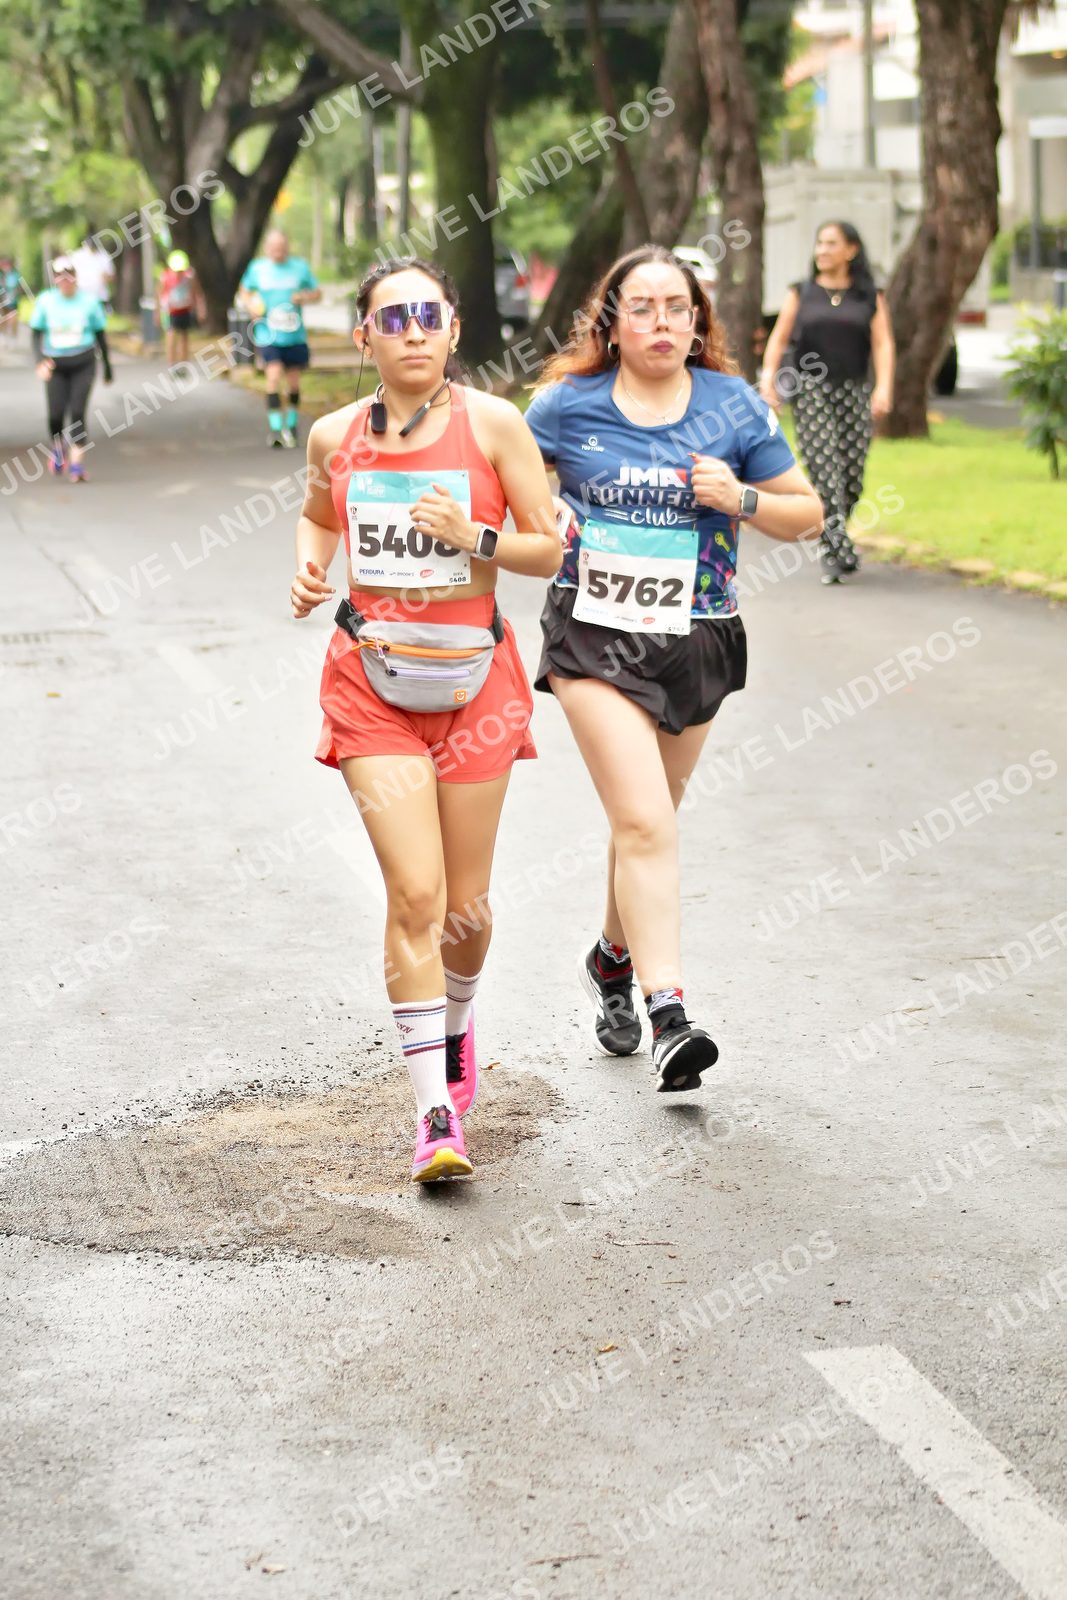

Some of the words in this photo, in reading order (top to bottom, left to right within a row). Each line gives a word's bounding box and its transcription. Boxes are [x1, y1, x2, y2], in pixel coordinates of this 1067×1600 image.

[613, 466, 687, 488] JMA
[587, 486, 699, 509] RUNNER
[630, 507, 678, 526] club
[587, 569, 684, 607] 5762
